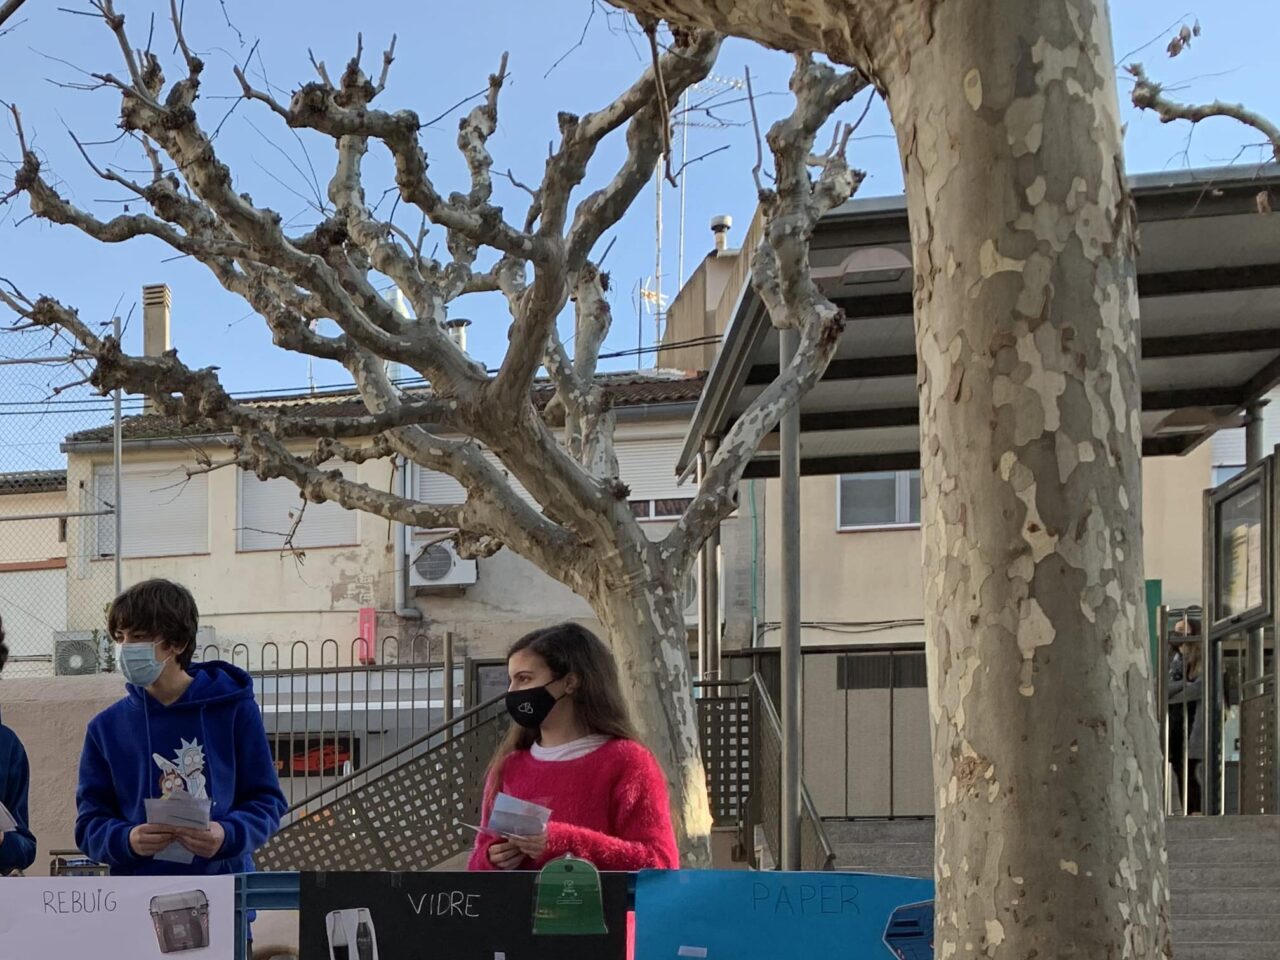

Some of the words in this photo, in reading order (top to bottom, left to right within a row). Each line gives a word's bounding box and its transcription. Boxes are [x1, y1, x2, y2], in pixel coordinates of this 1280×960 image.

[42, 888, 118, 914] REBUIG
[407, 890, 481, 918] VIDRE
[751, 882, 861, 915] PAPER
